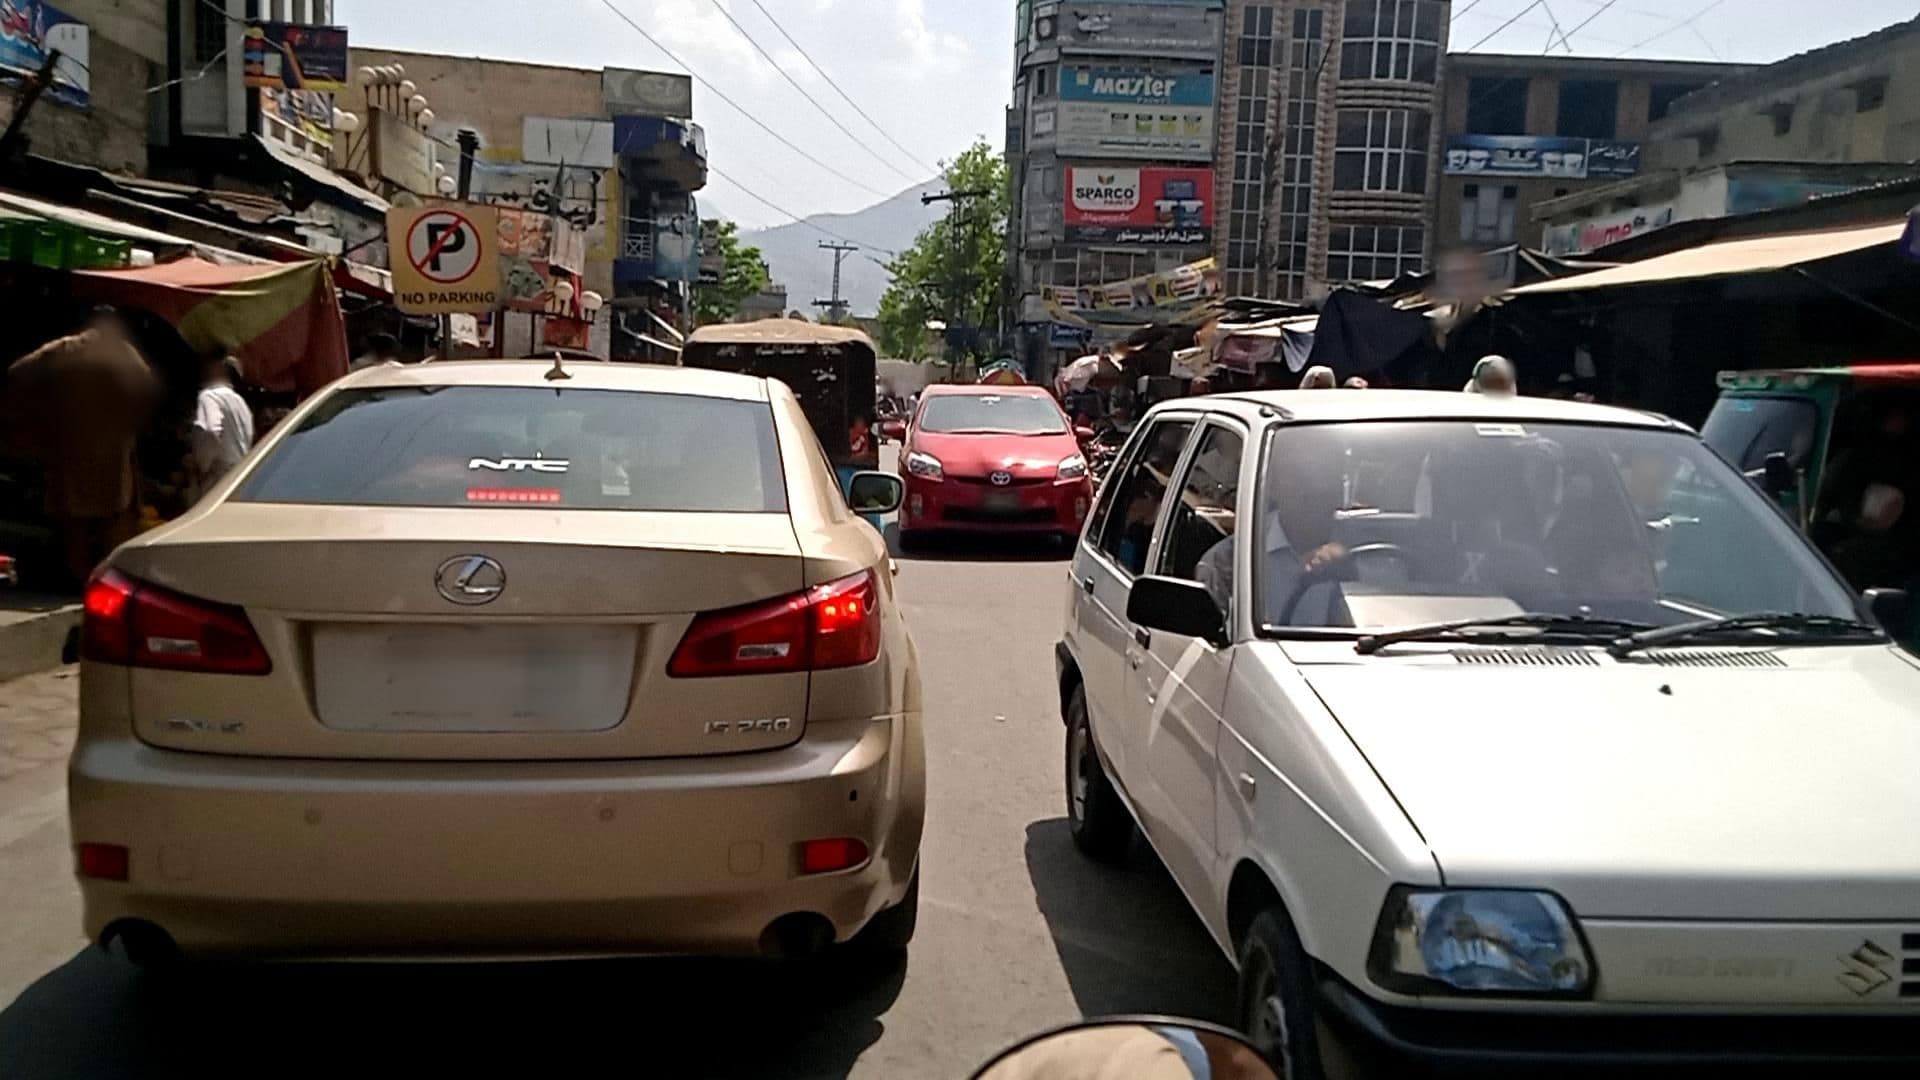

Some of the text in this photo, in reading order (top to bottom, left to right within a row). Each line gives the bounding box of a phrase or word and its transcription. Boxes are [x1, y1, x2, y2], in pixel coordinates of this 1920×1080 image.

[1076, 187, 1135, 200] SPARCO
[402, 291, 496, 305] NO PARKING
[737, 717, 791, 734] 250
